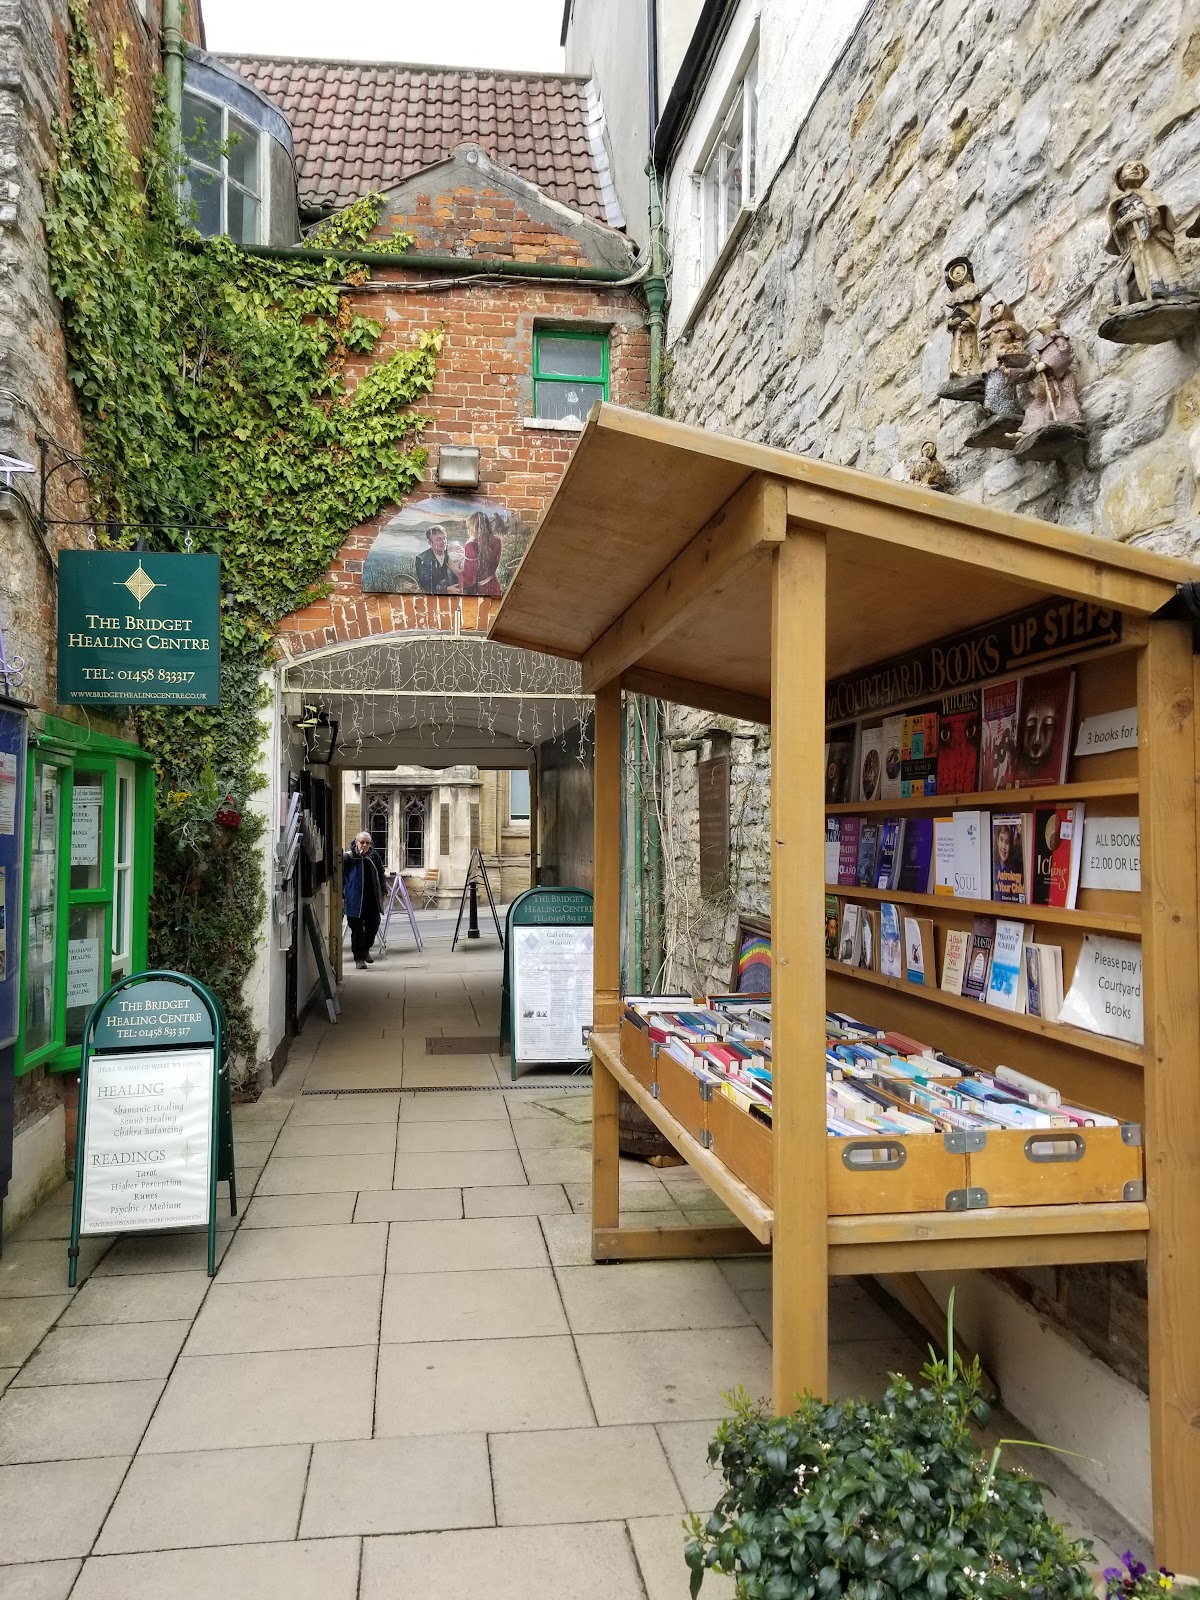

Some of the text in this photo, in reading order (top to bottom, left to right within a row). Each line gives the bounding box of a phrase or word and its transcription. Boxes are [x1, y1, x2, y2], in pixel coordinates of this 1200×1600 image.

[85, 614, 192, 631] THE BRIDGET
[1011, 600, 1113, 655] UP STEPS
[68, 633, 210, 650] HEALING CENTRE
[928, 635, 1000, 692] BOOKS
[82, 668, 195, 684] TEL: 01458 833317
[942, 690, 978, 714] WITCHES
[986, 692, 1015, 712] FUTURE
[1087, 732, 1092, 744] 3
[1094, 728, 1119, 743] books
[1121, 725, 1134, 738] for
[1096, 834, 1140, 846] ALL BOOKS
[1091, 856, 1112, 869] £2.00
[1115, 858, 1127, 870] OR
[955, 873, 977, 891] SOUL
[997, 870, 1022, 882] Astrology
[999, 881, 1011, 893] Your
[1095, 952, 1120, 968] Please
[1122, 960, 1137, 975] pay
[1099, 976, 1140, 997] Courtyard
[119, 1000, 190, 1012] THE BRIDGET
[1105, 1001, 1131, 1019] Books
[106, 1013, 202, 1026] HEALING CENTRE
[117, 1027, 190, 1038] TEL: 01458 833 317
[97, 1083, 164, 1098] HEALING
[114, 1101, 184, 1115] Shamanic Healing
[120, 1114, 177, 1125] Sound Healing
[114, 1125, 183, 1137] Chakra Balancing
[92, 1150, 166, 1165] READINGS
[136, 1170, 157, 1178] Tarot
[111, 1179, 182, 1192] Higher Perception
[134, 1192, 158, 1200] Runes
[110, 1203, 139, 1215] Psychic
[149, 1201, 181, 1211] Medium
